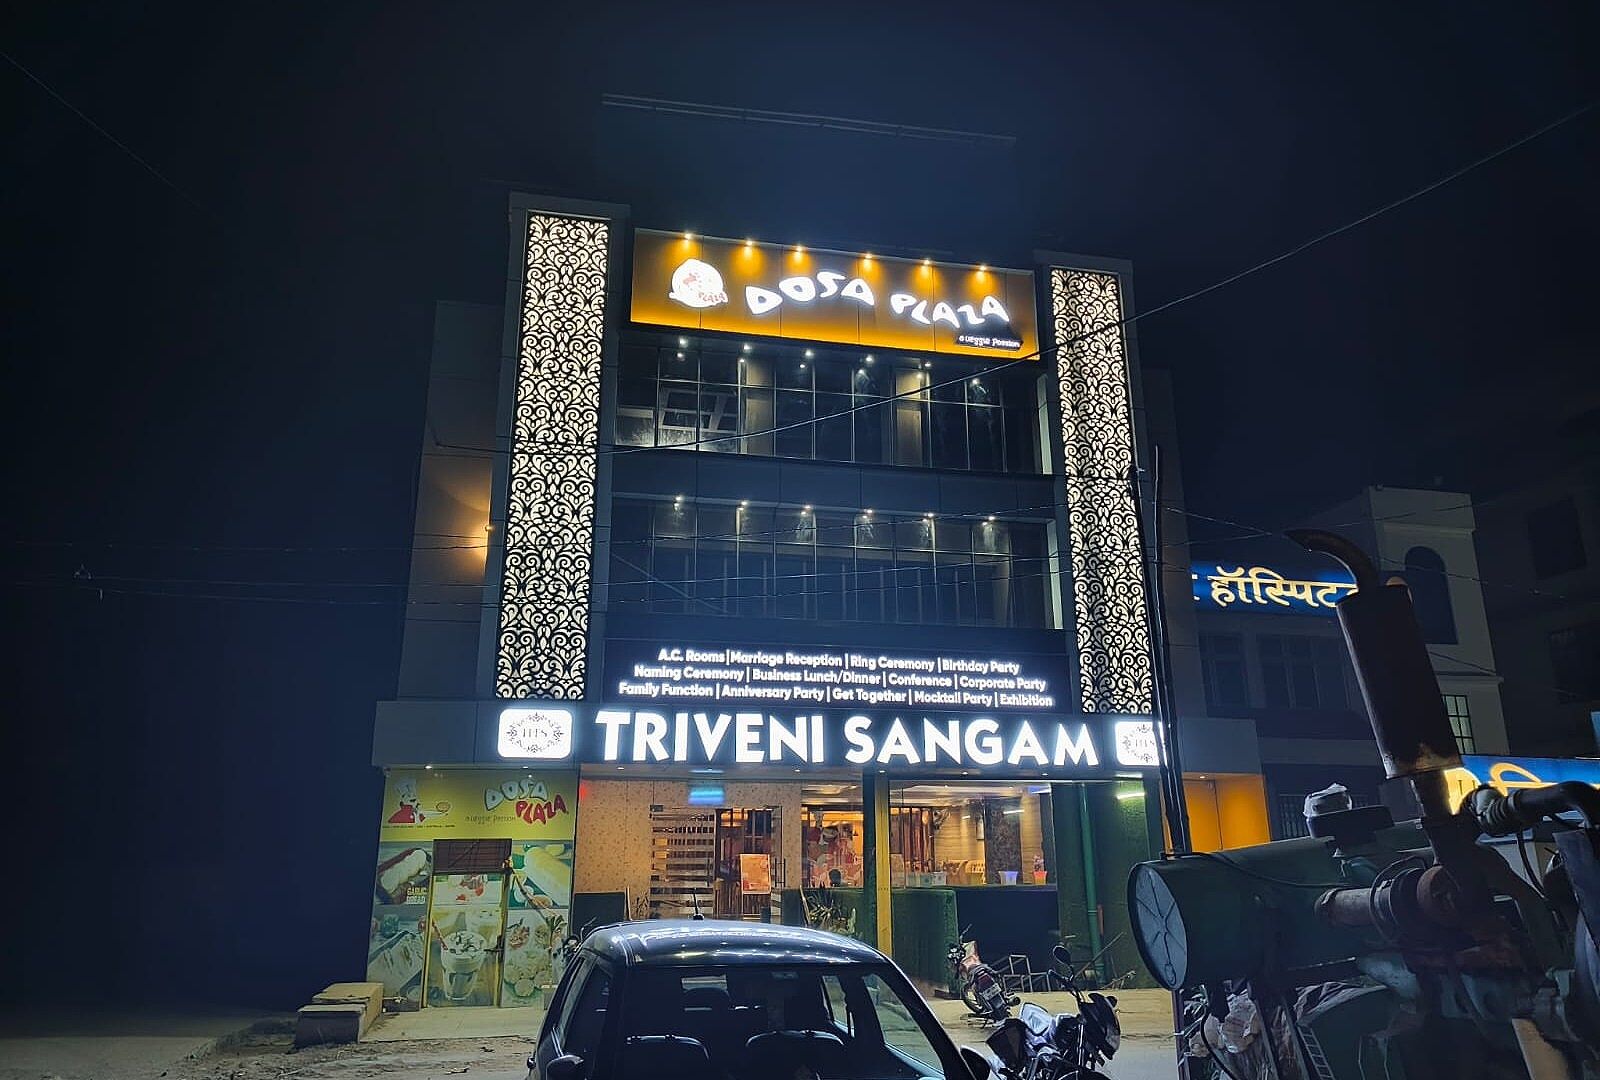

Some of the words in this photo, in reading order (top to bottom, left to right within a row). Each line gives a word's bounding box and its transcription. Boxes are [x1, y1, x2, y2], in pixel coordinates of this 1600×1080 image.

[890, 293, 1010, 329] PLAZA
[1207, 565, 1359, 608] हॉस्पिट
[658, 648, 684, 662] A.C.
[686, 649, 725, 663] Rooms
[729, 651, 784, 667] Marriage
[786, 653, 843, 668] Reception
[850, 656, 876, 671] Ring
[878, 656, 934, 672] Ceremony
[942, 658, 988, 674] Birthday
[990, 660, 1020, 676] Party
[618, 682, 660, 697] Family
[661, 683, 713, 697] Function
[722, 684, 791, 701] Anniversary
[793, 686, 824, 702] Party
[832, 687, 854, 700] Get
[855, 688, 907, 703] Together
[914, 690, 961, 704] Mocktail
[963, 692, 992, 707] Party
[999, 693, 1053, 707] Exhibition
[634, 665, 682, 681] Naming
[683, 666, 744, 683] Ceremony
[752, 669, 802, 682] Business
[804, 669, 881, 685] Lunch/Dinner
[888, 674, 953, 687] Conference
[959, 676, 1015, 690] Corporate
[1017, 677, 1046, 692] Party
[595, 710, 825, 763] TRIVENI
[843, 716, 1100, 767] SANGAM
[515, 793, 567, 825] PLAZA
